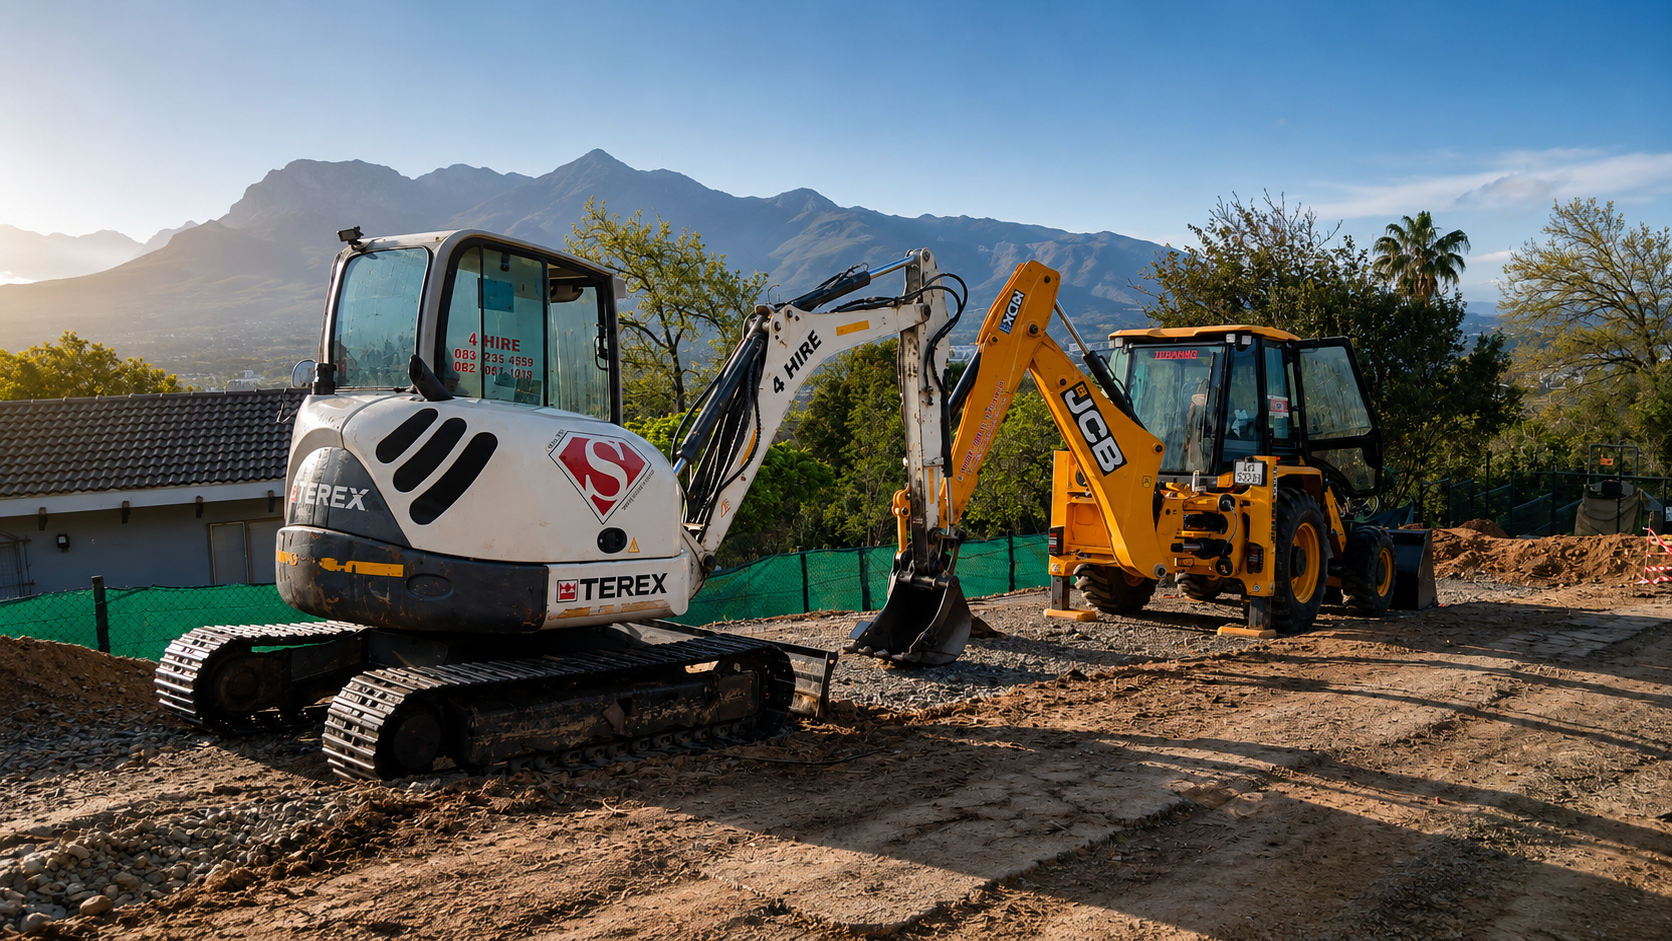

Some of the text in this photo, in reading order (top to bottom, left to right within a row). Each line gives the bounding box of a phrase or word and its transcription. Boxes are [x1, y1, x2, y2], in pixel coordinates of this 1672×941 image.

[454, 348, 477, 361] 083
[468, 332, 521, 352] 4 HIRE
[773, 329, 822, 394] 4 HIRE
[1064, 389, 1124, 472] JCB
[299, 481, 370, 512] TEREX
[580, 573, 668, 601] TEREX
